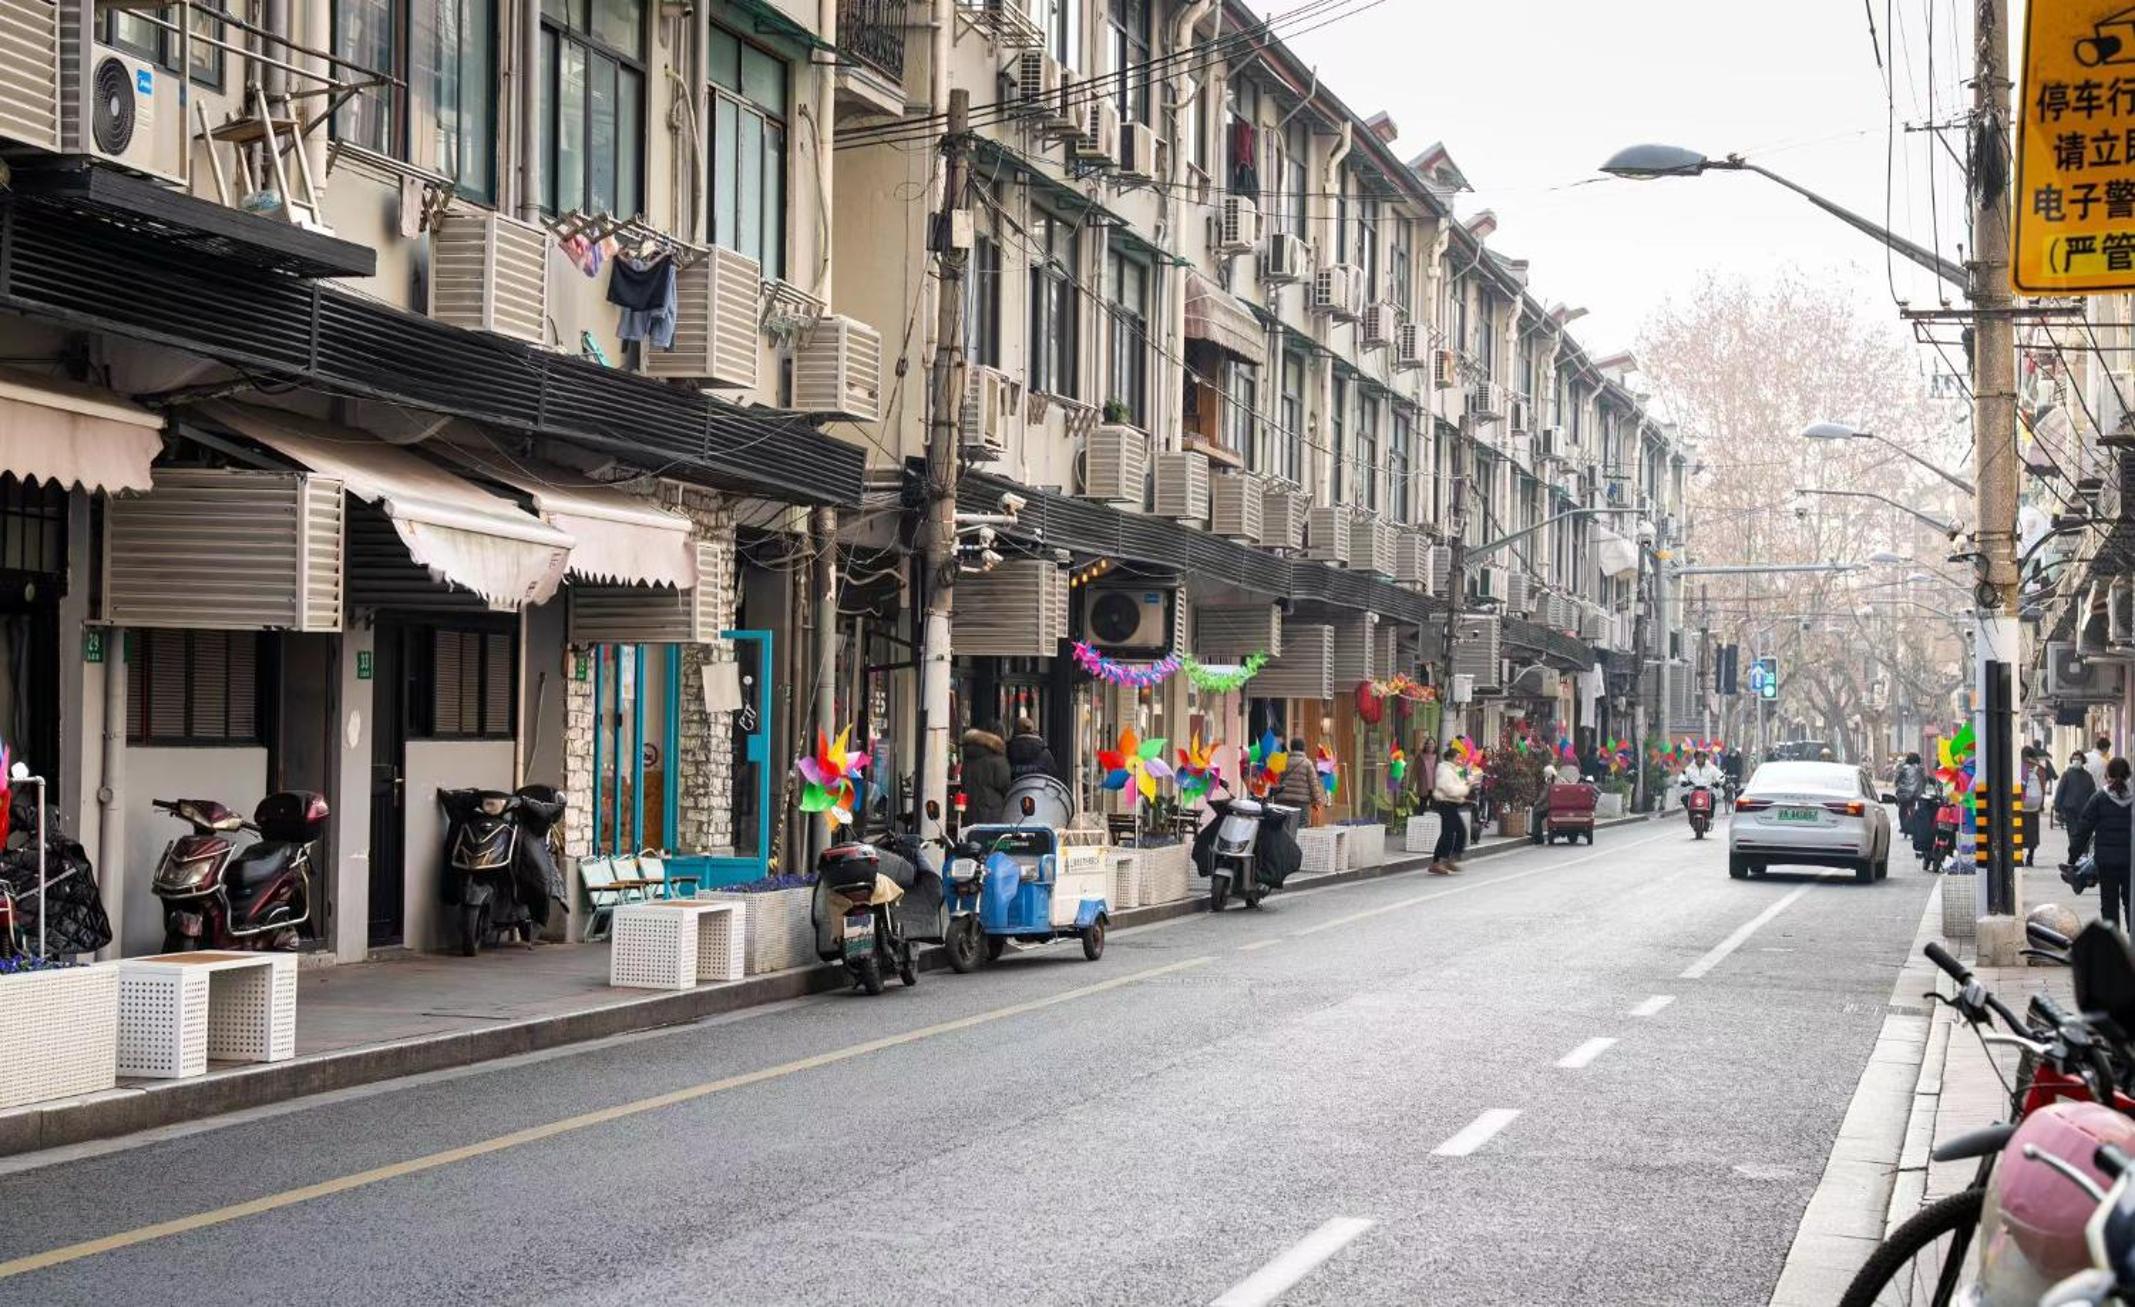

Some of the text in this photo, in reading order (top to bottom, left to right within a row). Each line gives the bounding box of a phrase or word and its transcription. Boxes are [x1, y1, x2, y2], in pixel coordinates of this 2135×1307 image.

[2036, 77, 2135, 123] 停车行
[2033, 178, 2135, 222] 电子警
